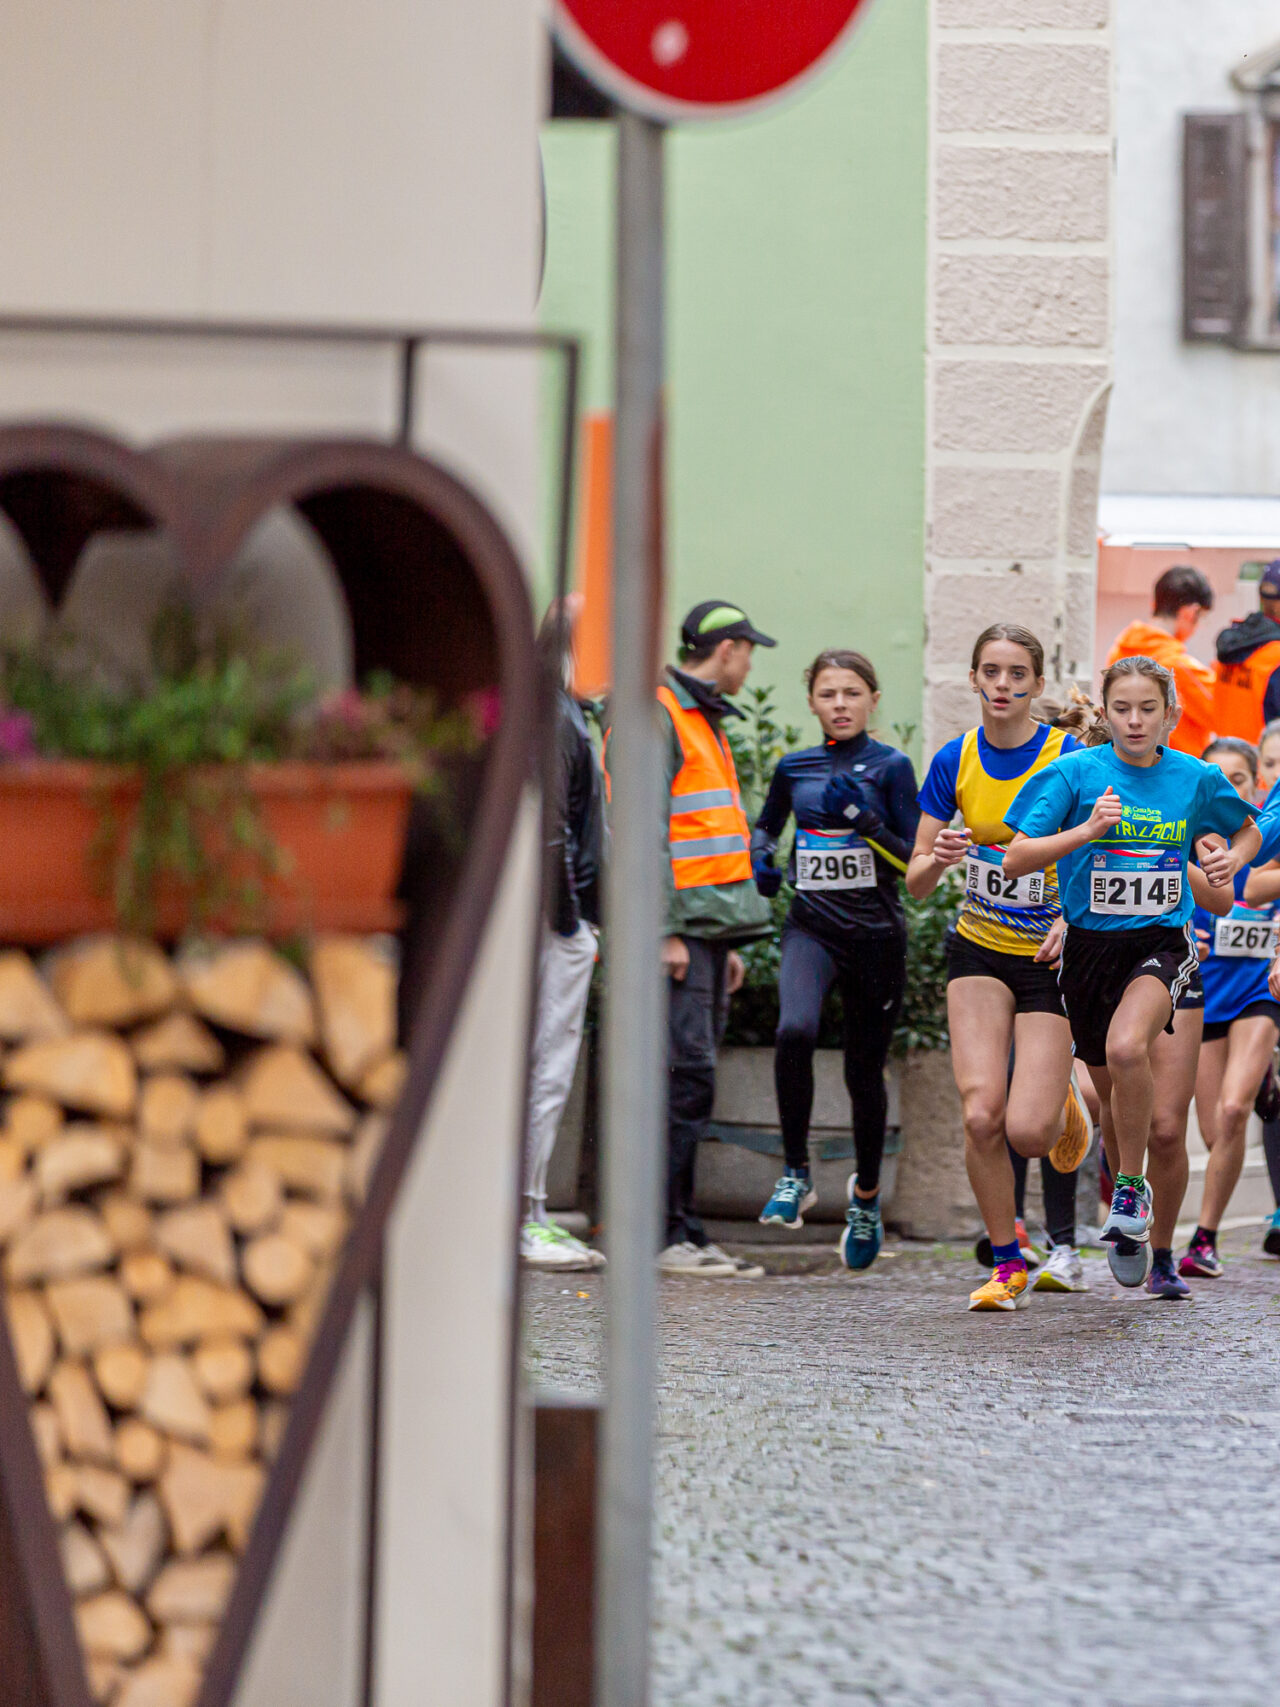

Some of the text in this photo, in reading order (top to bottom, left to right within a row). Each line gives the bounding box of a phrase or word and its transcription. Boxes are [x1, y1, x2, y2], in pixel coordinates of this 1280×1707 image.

[809, 855, 857, 880] 296
[1107, 877, 1166, 905] 214
[1230, 926, 1272, 948] 267
